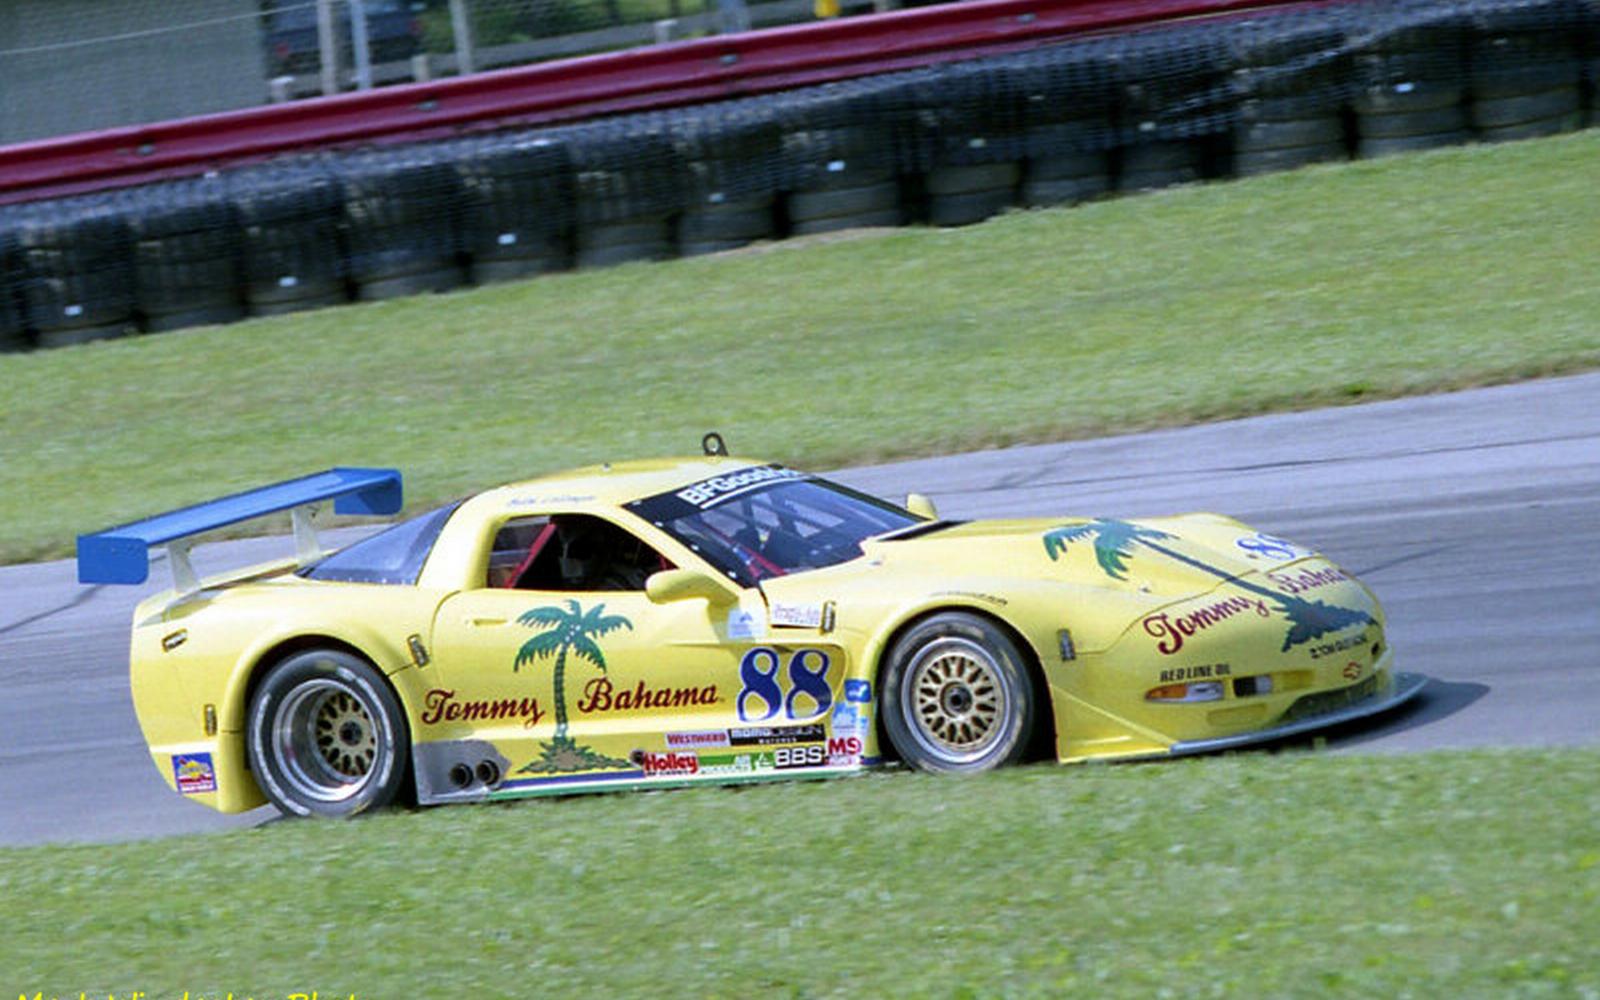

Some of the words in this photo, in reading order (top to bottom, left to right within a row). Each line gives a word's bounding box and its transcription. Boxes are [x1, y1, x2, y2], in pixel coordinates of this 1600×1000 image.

[1143, 595, 1270, 655] Tommy
[421, 688, 546, 729] Tommy
[577, 675, 720, 714] Bahama
[736, 646, 834, 723] 88
[643, 752, 698, 774] Holley
[775, 746, 824, 766] BBS
